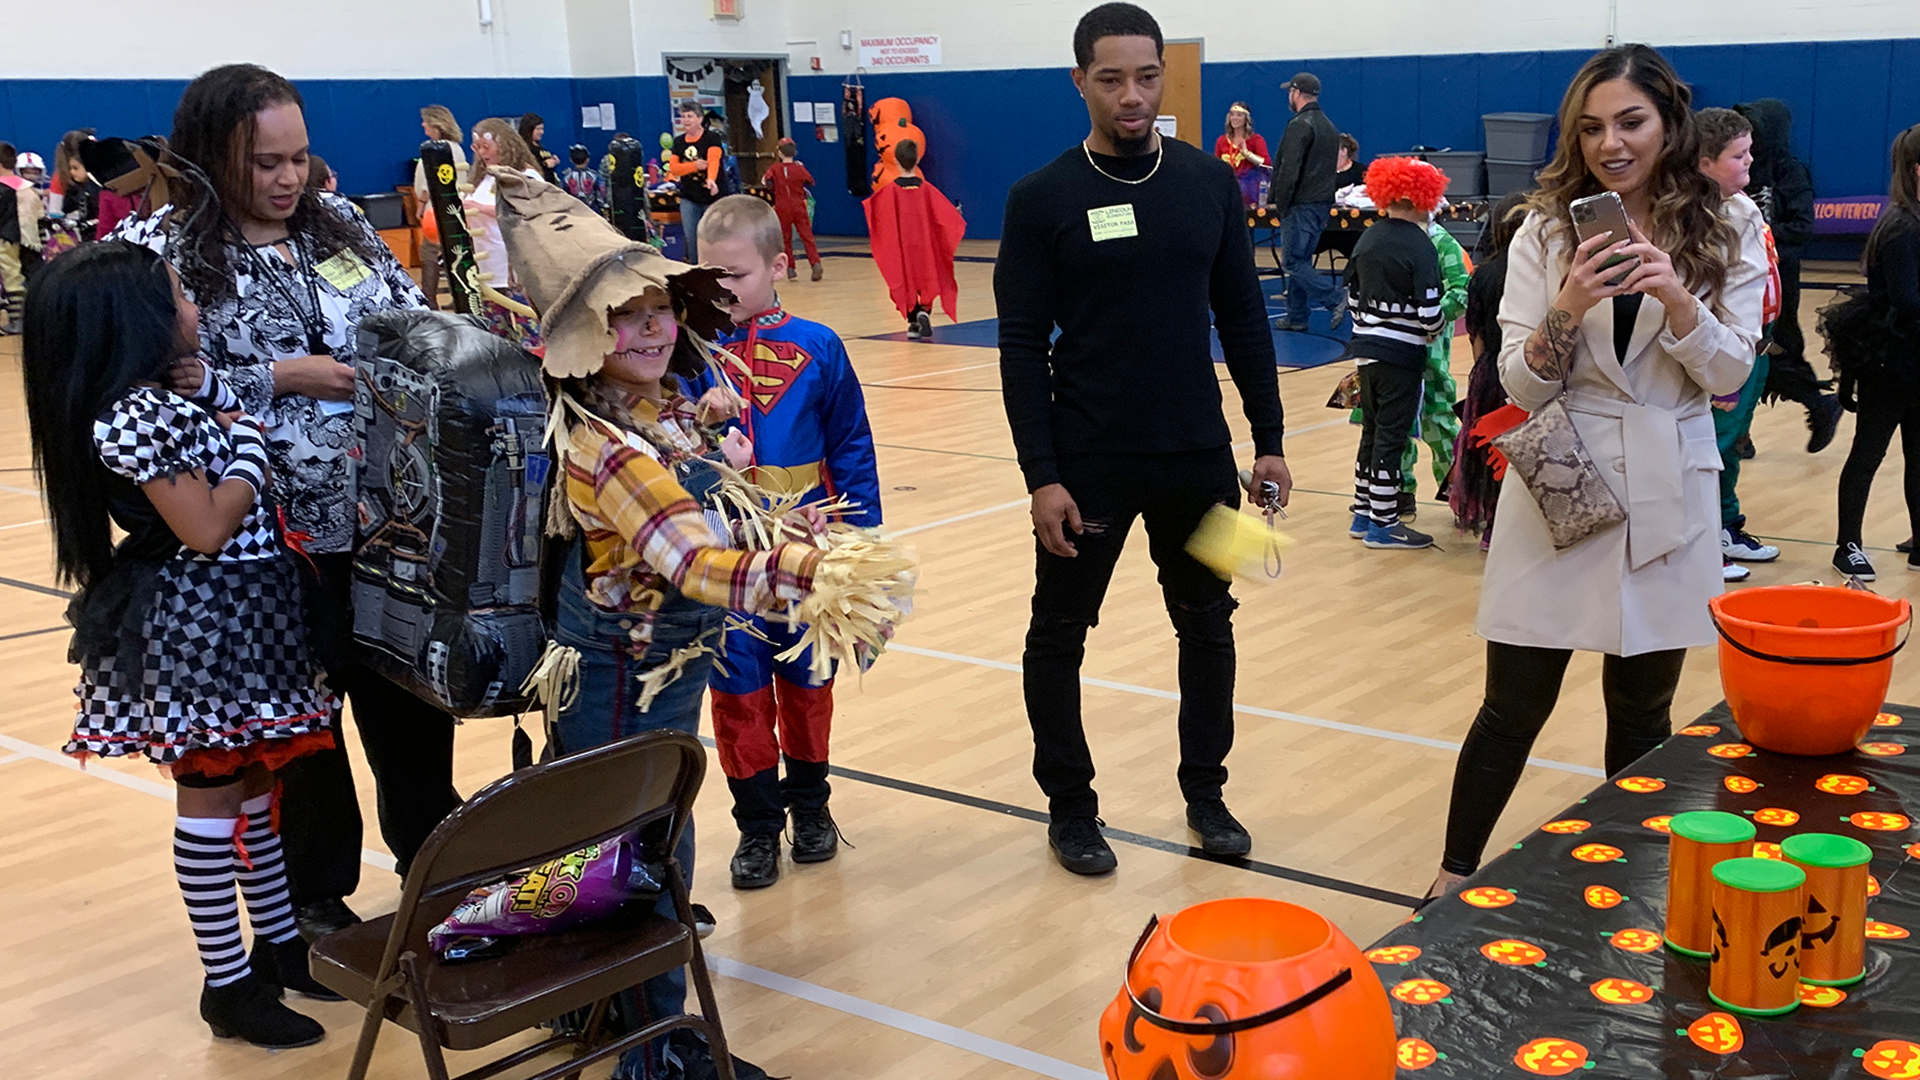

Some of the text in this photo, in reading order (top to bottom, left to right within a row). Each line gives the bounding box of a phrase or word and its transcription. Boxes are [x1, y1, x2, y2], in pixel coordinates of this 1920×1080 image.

[860, 36, 938, 47] MAXIMUM OCCUPANCY
[871, 55, 930, 65] 340 OCCUPANTS
[1814, 203, 1881, 220] LLOWIENER!
[1093, 222, 1119, 230] VISITOR
